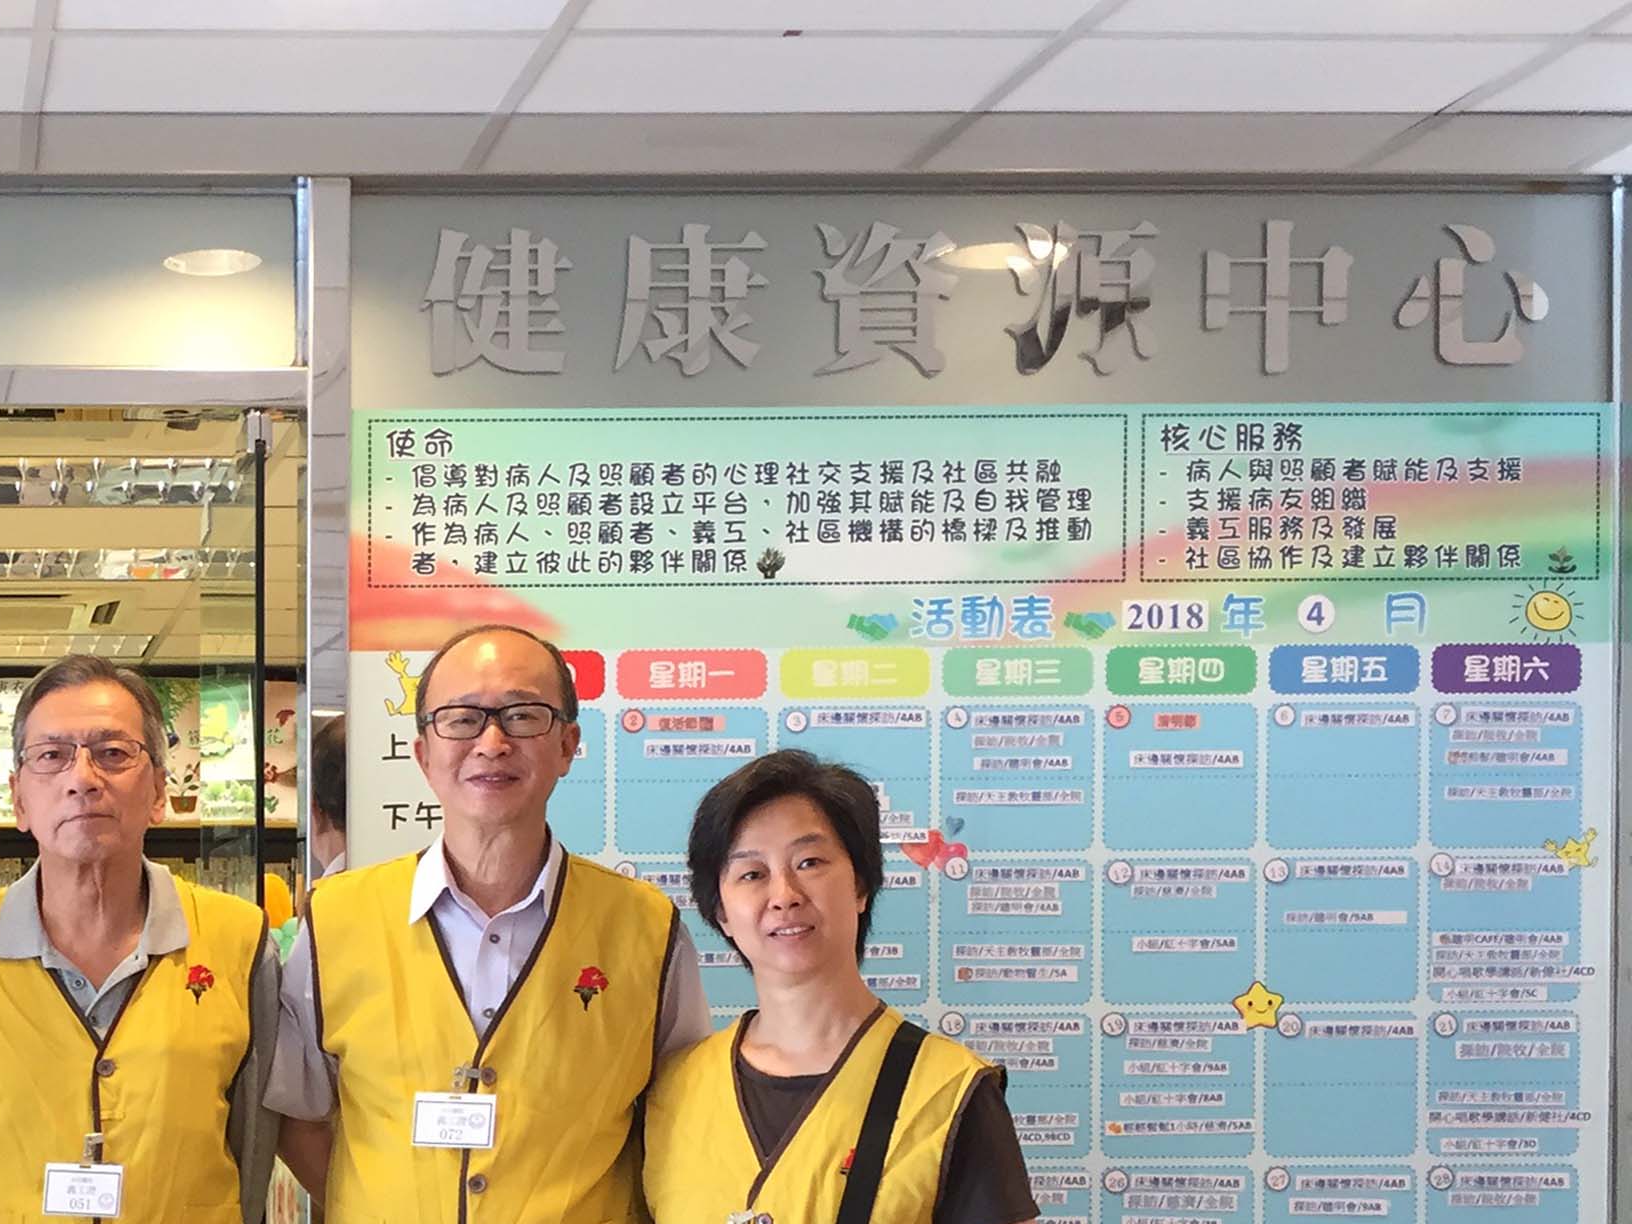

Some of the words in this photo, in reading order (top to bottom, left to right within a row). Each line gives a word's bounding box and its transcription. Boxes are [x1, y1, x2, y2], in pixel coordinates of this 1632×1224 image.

[421, 219, 1550, 378] 健康資源中心
[386, 428, 453, 458] 使命
[1160, 422, 1304, 453] 核心服務
[411, 459, 1062, 488] 倡導對病人及照顧者的心理社交支援及社區共融
[1185, 456, 1523, 483] 病人與照顧者賦能及支援
[1186, 488, 1368, 512] 支援病友組織
[1186, 516, 1398, 541] 義工服務及發展
[1184, 544, 1523, 570] 社區協作及建立夥伴關係
[911, 595, 1054, 638] 活動表
[1126, 602, 1204, 632] 2018
[1221, 593, 1265, 637] 年
[1305, 601, 1326, 627] 4
[1384, 592, 1428, 637] 月
[648, 660, 736, 689] 星期一
[811, 659, 898, 687] 星期二
[975, 657, 1063, 686] 星期三
[1138, 656, 1225, 684] 星期四
[1301, 655, 1389, 683] 星期五
[1463, 655, 1551, 683] 星期六
[382, 733, 411, 760] 上
[382, 800, 443, 830] 下午
[439, 1128, 464, 1140] 072
